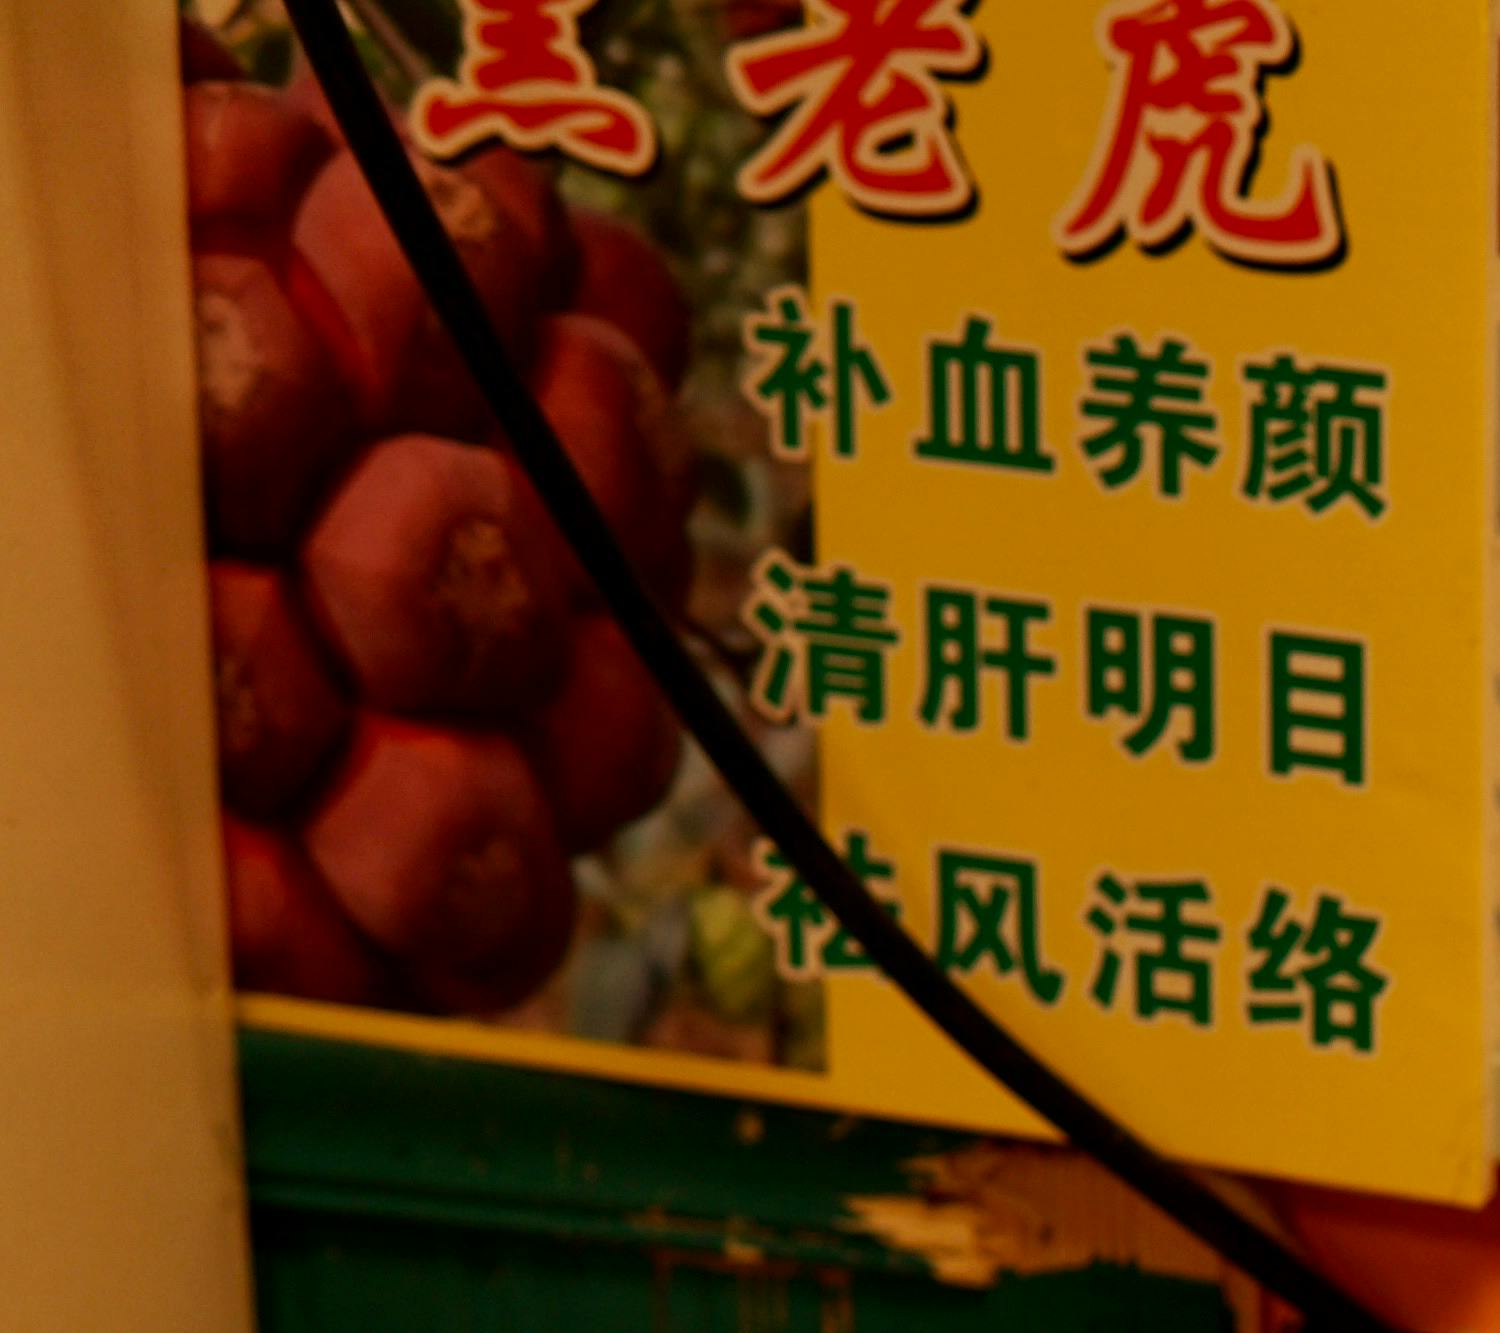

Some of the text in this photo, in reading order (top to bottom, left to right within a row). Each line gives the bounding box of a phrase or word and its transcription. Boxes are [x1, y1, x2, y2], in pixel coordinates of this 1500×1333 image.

[752, 298, 1390, 520] 补血养颜
[752, 560, 1370, 788] 清肝明目
